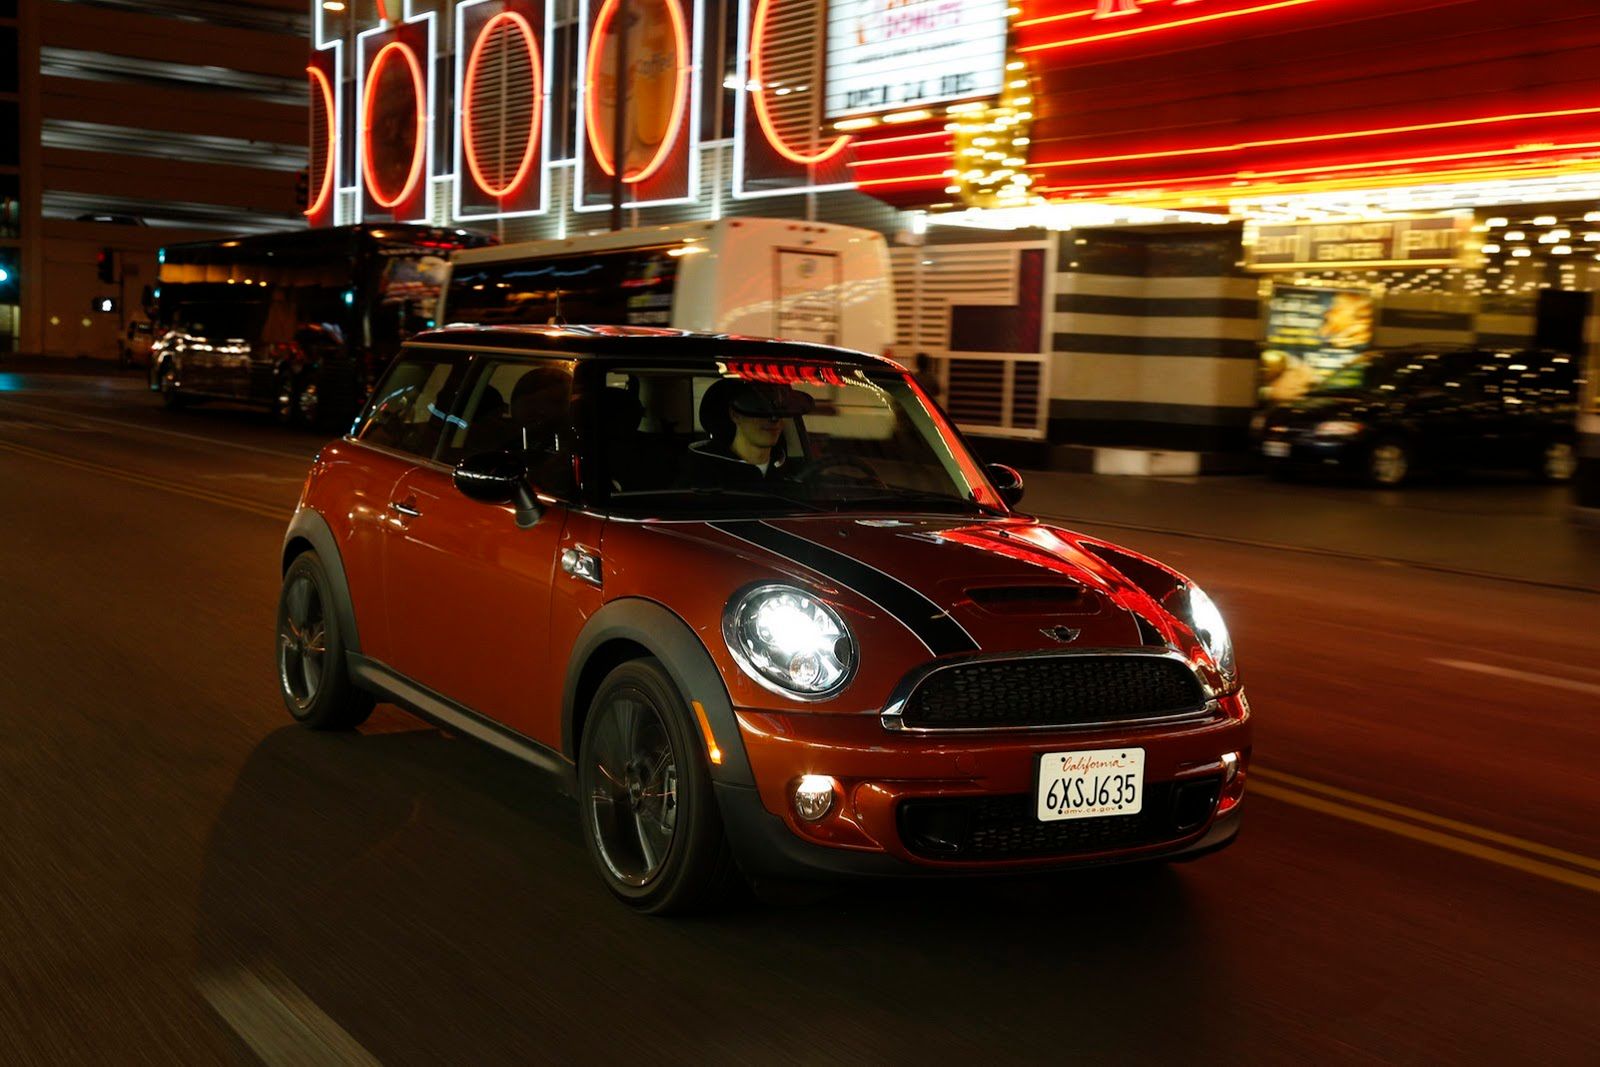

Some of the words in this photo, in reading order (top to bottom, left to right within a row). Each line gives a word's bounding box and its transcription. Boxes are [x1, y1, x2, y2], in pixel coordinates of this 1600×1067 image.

[1062, 756, 1125, 775] California
[1046, 774, 1136, 810] 6XSJ635
[1064, 806, 1116, 815] dmv.ca.gov
